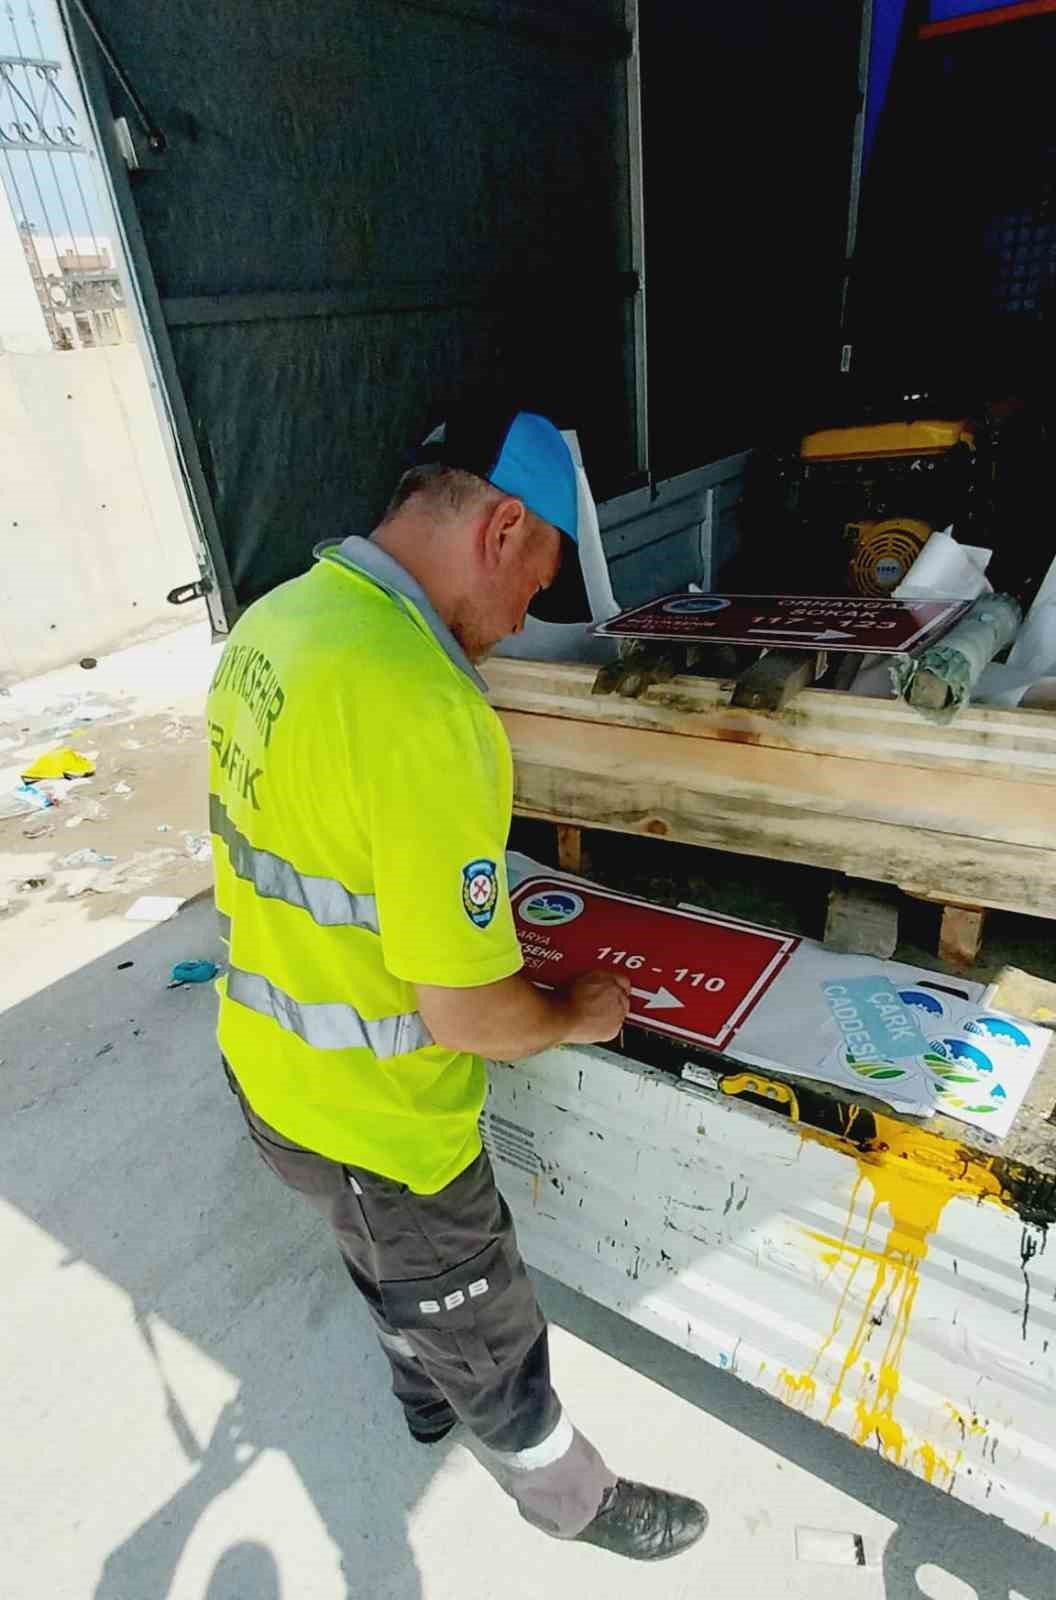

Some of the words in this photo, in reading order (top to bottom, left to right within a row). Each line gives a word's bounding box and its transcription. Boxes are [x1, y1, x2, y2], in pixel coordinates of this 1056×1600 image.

[752, 616, 806, 625] 117
[839, 620, 897, 630] 123
[789, 608, 879, 619] SOKAK
[208, 719, 264, 811] RAFİK
[597, 947, 646, 969] 116
[674, 968, 726, 992] 110
